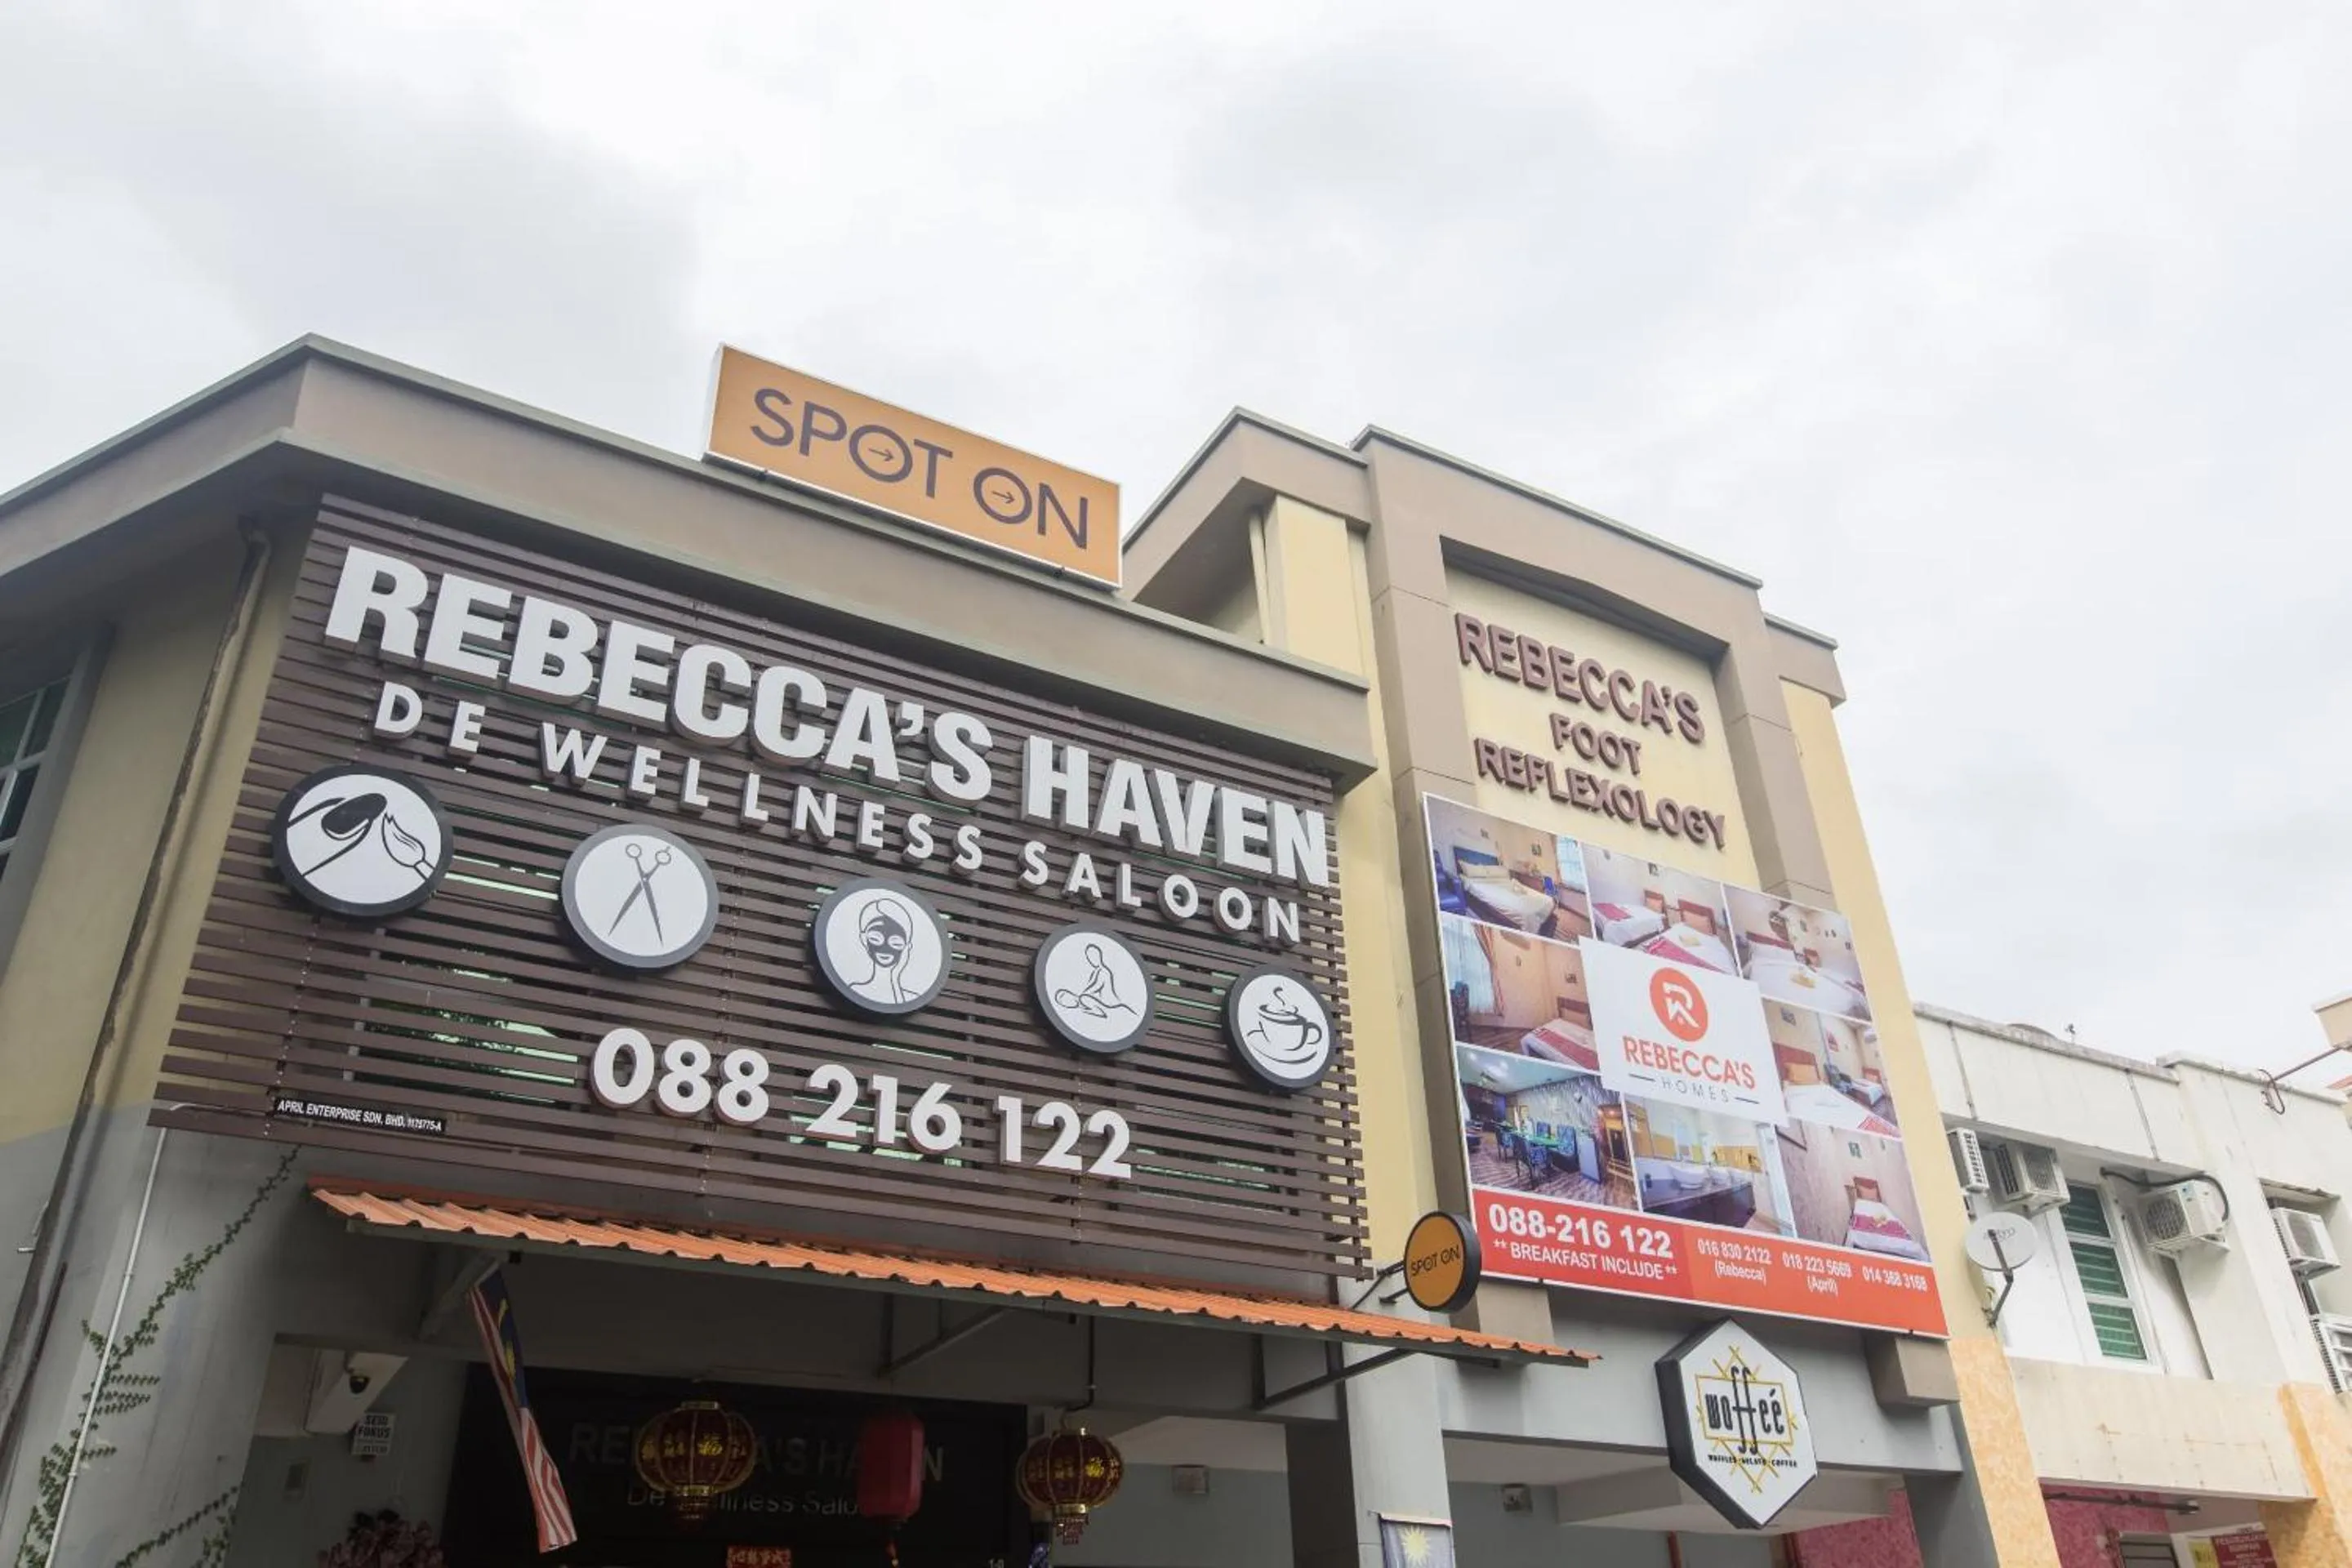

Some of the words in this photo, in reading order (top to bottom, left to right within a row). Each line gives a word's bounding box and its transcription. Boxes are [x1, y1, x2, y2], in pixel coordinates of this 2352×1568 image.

[751, 387, 954, 499] SPOT
[973, 466, 1089, 550] ON
[1455, 612, 1705, 744] REBECCA'S
[324, 546, 994, 804] REBECCA'S
[1022, 735, 1330, 887] HAVEN
[1549, 712, 1641, 776] FOOT
[373, 681, 487, 757] DE
[541, 720, 983, 871] WELLNESS
[1018, 840, 1302, 945] SALOON
[1474, 737, 1726, 850] REFLEXOLOGY
[1622, 1035, 1756, 1090] REBECCA'S
[1662, 1076, 1729, 1102] HOMES
[277, 1099, 304, 1114] APRIL
[306, 1102, 362, 1122] ENTERPRISE
[590, 1027, 769, 1125] 088
[804, 1063, 962, 1155] 216
[995, 1094, 1132, 1180] 122
[1411, 1252, 1438, 1276] SPOT
[1441, 1245, 1460, 1265] ON
[1489, 1204, 1611, 1249] 088-216
[1620, 1224, 1673, 1259] 122
[1511, 1242, 1597, 1269] BREAKFAST
[1744, 1245, 1772, 1265] 2122
